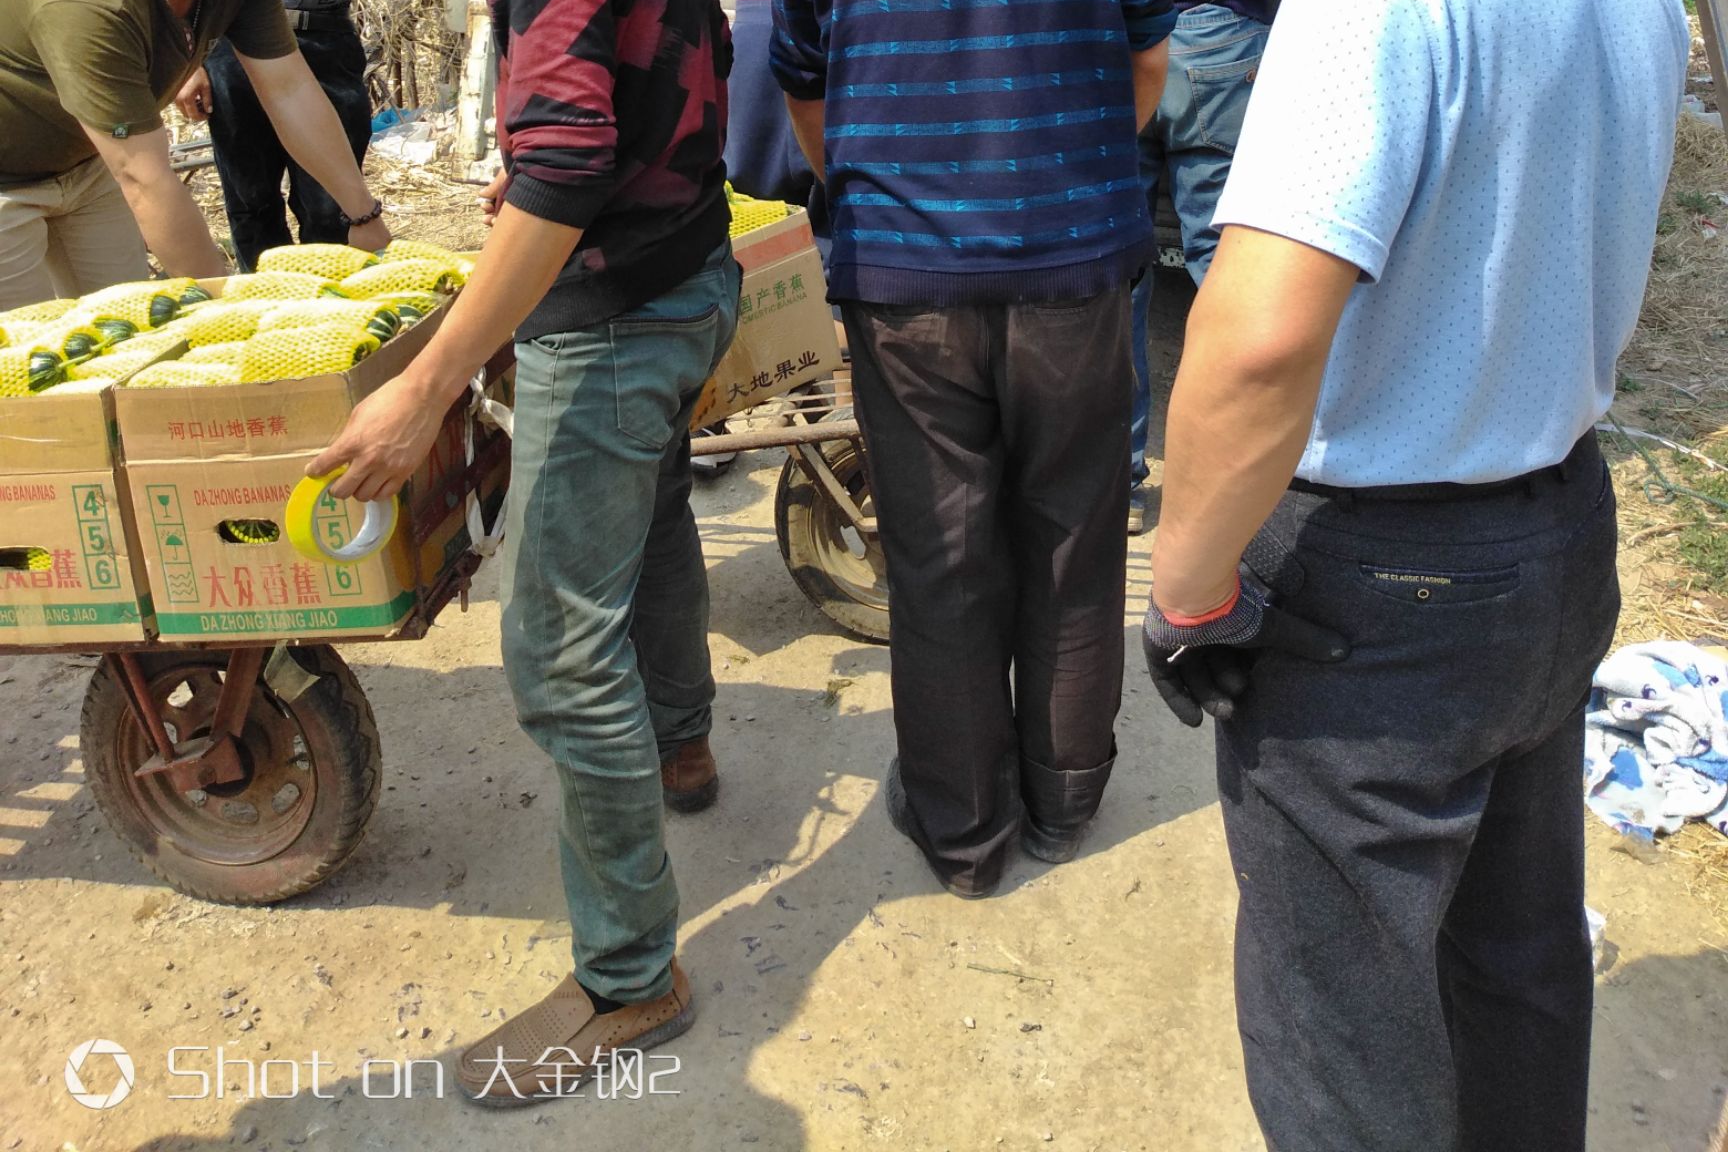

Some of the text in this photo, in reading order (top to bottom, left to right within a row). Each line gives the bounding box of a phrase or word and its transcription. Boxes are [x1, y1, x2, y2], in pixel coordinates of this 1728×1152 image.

[740, 272, 805, 313] 国产香蕉
[728, 350, 820, 403] 大地果业
[168, 415, 288, 440] 河口山地香蕉
[13, 484, 56, 501] BANANAS
[83, 489, 100, 516] 4
[243, 484, 291, 504] BANANAS
[319, 491, 337, 512] 4
[88, 525, 105, 551] 5
[328, 521, 344, 549] 5
[95, 559, 112, 585] 6
[203, 561, 322, 608] 大众香蕉
[335, 563, 352, 589] 6
[1374, 572, 1451, 585] THE CLASSIC FASHION
[72, 607, 97, 622] JIAO
[265, 611, 307, 630] XIANG
[309, 610, 338, 627] JIAO
